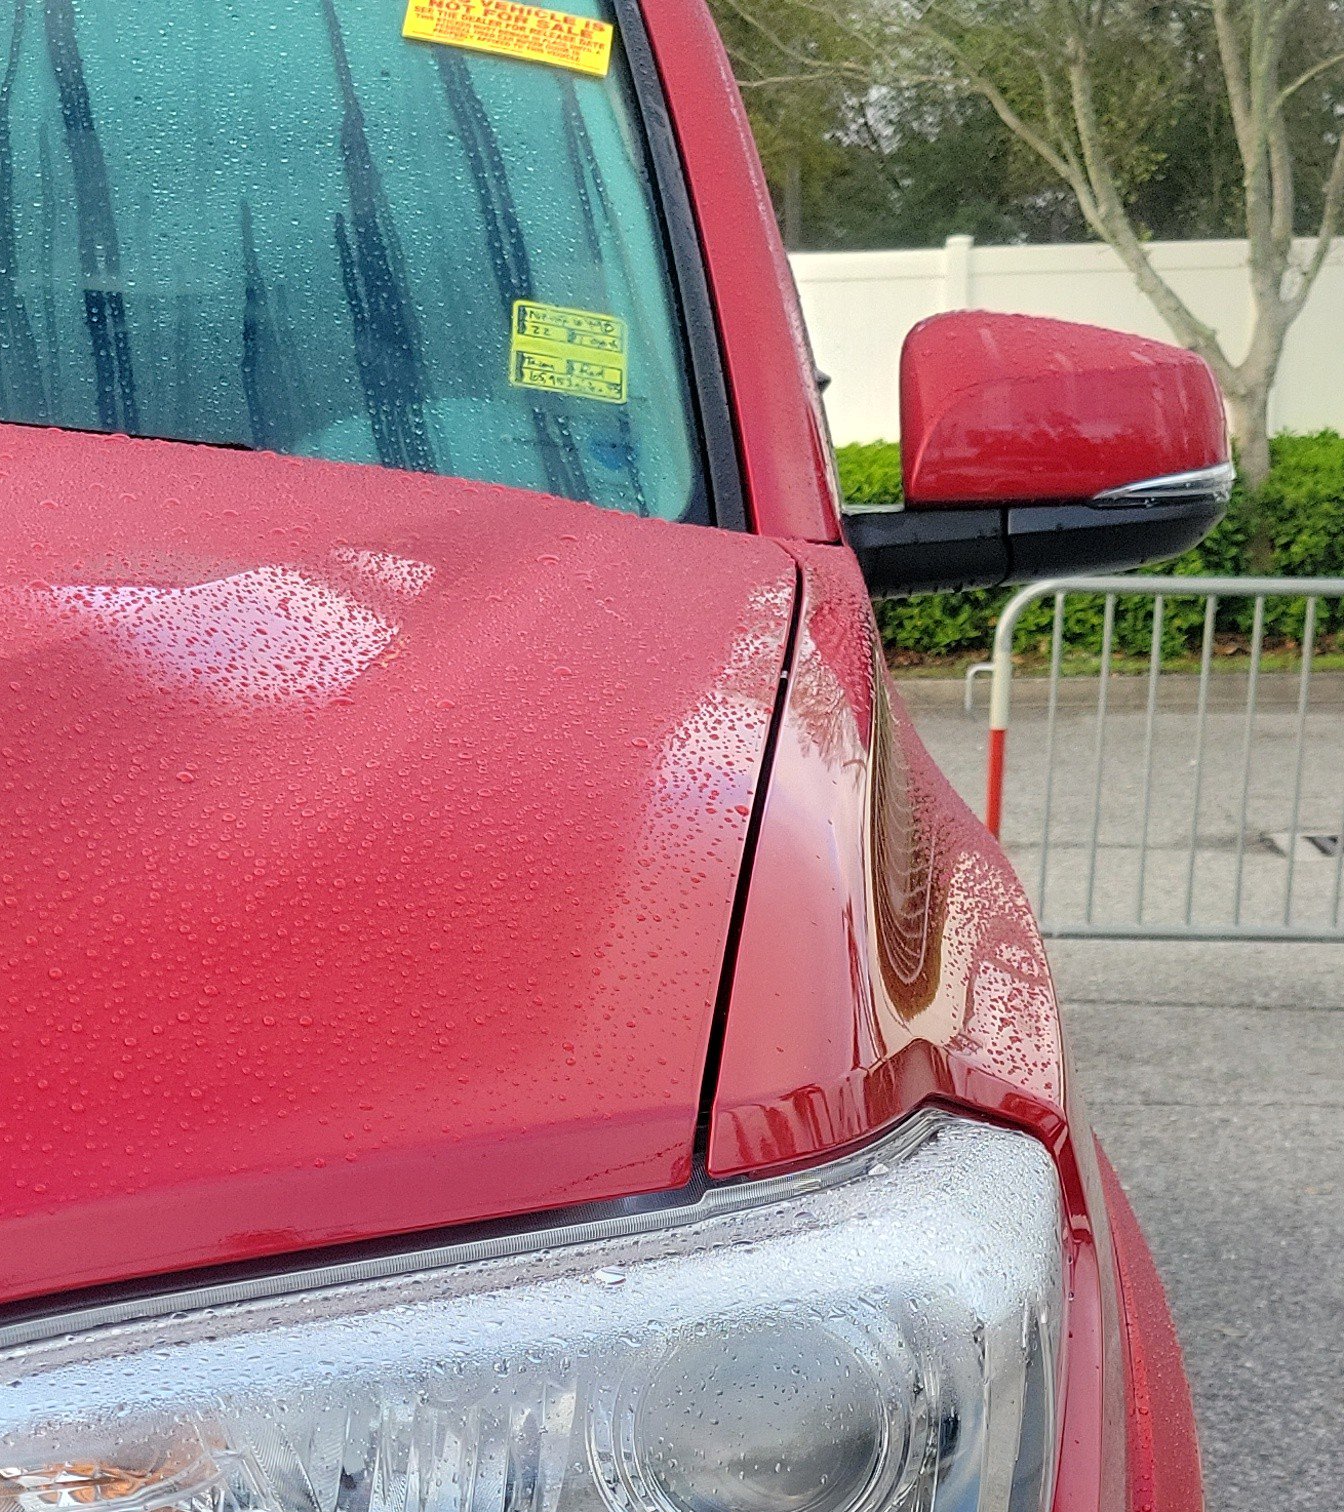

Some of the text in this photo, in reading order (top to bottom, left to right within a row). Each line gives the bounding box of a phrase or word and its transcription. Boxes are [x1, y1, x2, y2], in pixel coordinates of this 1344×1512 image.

[414, 5, 605, 50] SEE THE DEALER FOR RELEASE DATE
[429, 0, 594, 39] NOT FOR SALE
[481, 0, 606, 32] VEHICLE IS
